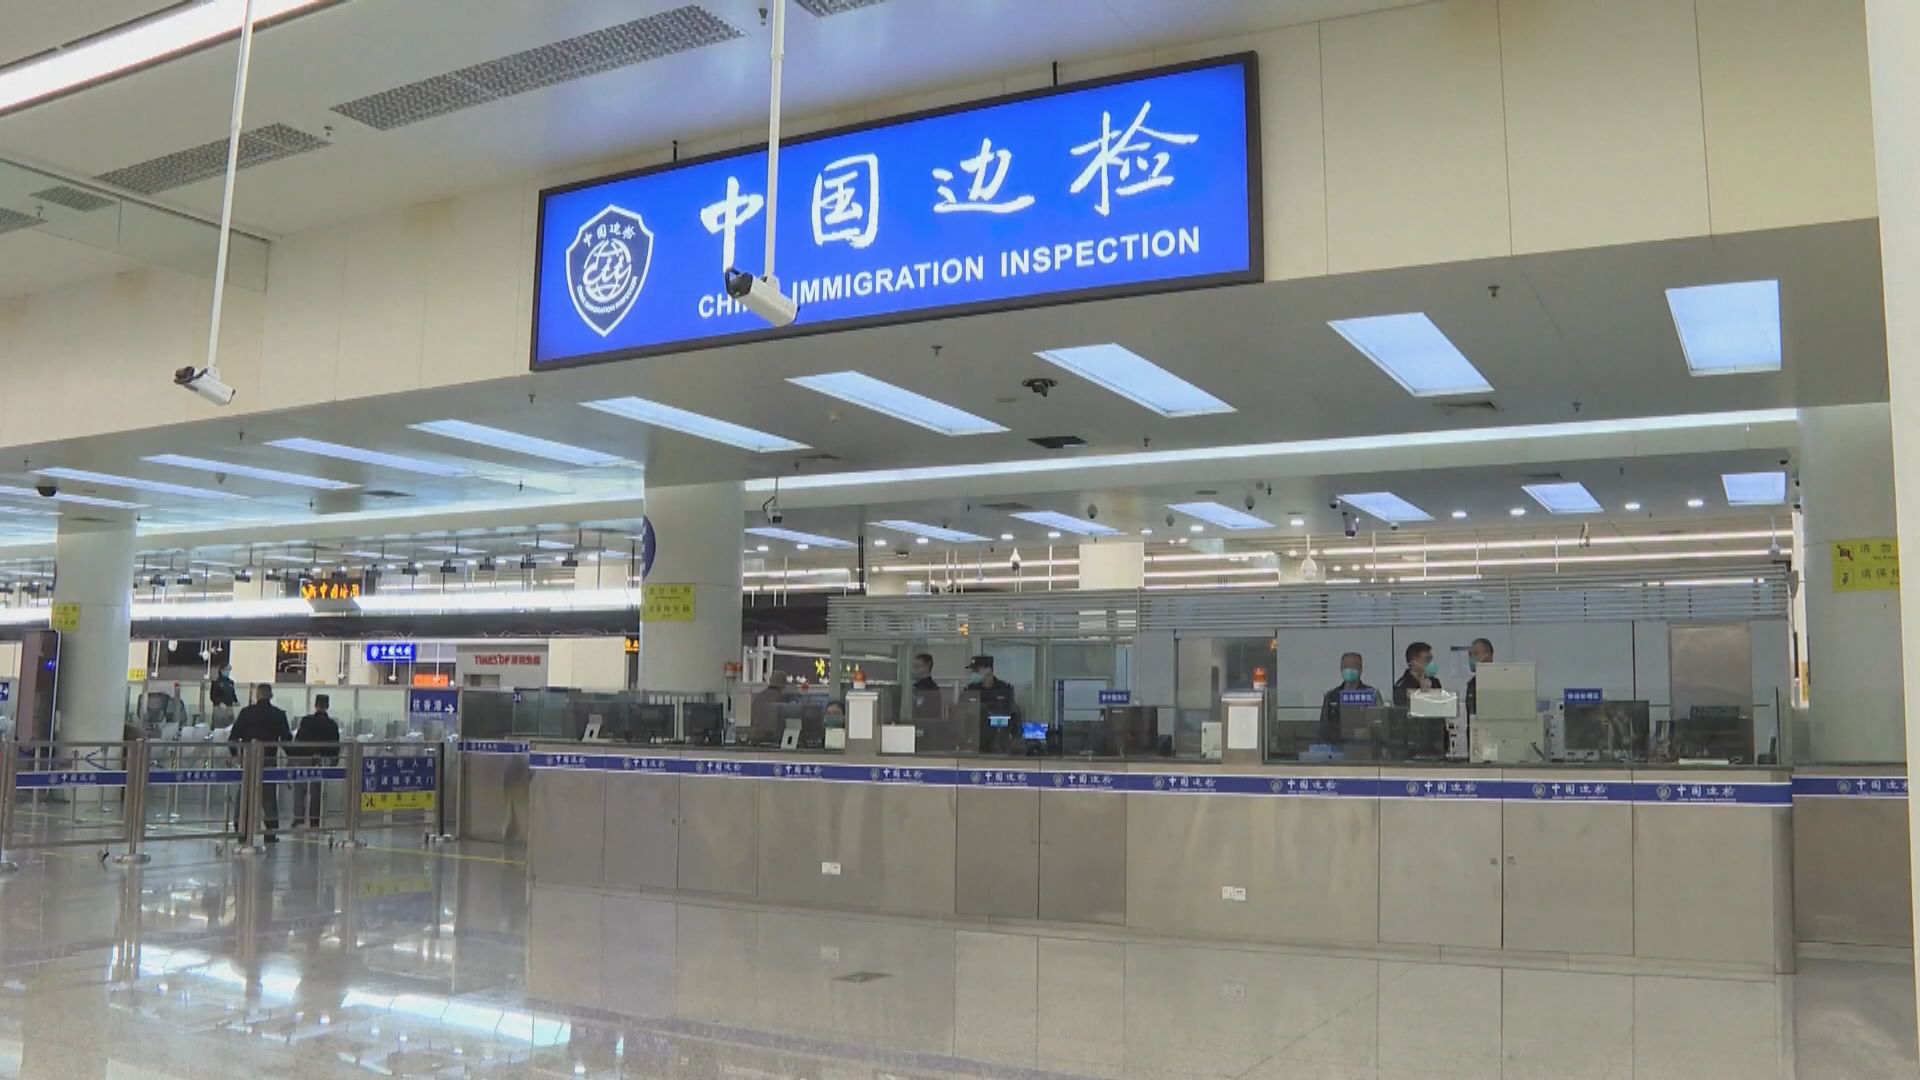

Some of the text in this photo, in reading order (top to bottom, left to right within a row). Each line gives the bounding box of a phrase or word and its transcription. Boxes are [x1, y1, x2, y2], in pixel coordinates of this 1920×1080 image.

[700, 101, 1199, 273] 中国边检
[698, 226, 1200, 318] CHI IMMIGRATION INSPECTION
